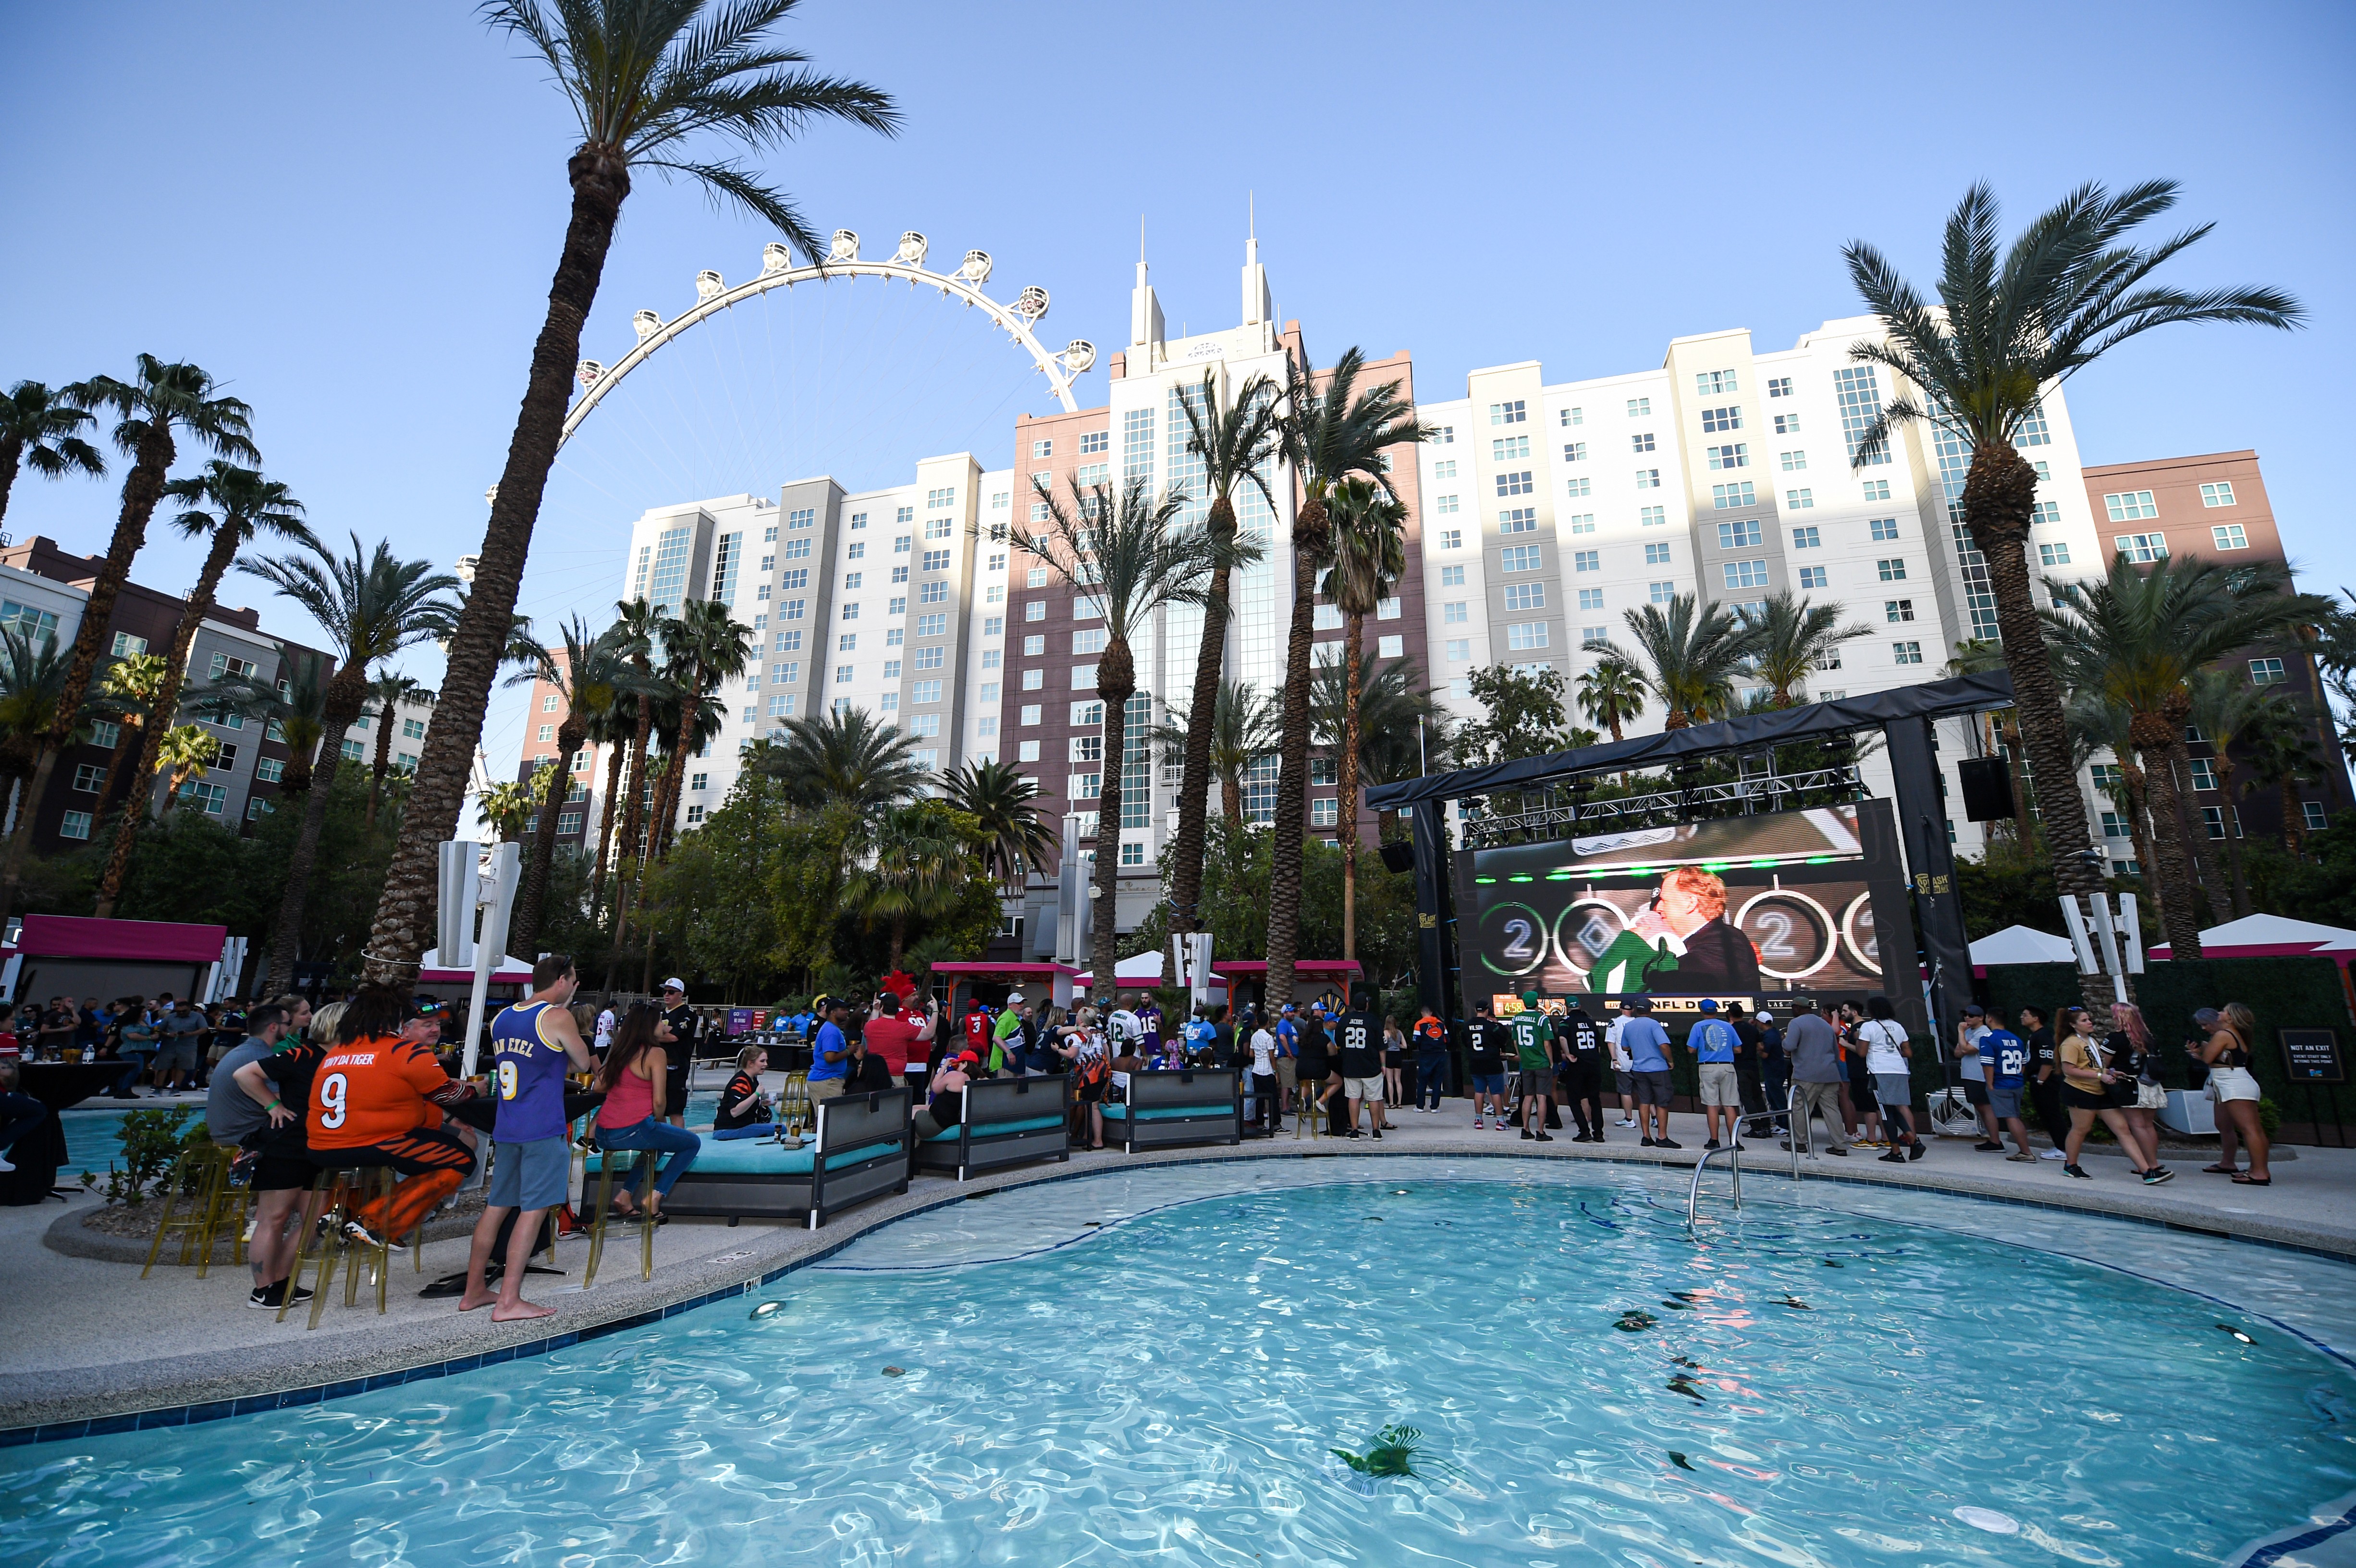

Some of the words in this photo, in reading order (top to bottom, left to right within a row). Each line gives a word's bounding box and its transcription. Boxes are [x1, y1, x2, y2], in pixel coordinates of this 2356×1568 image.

[1504, 1002, 1522, 1013] 4:58
[596, 1021, 603, 1036] 6
[973, 1021, 981, 1033] 3
[1111, 1022, 1125, 1043] 12
[1141, 1016, 1156, 1034] 16
[1345, 1027, 1366, 1049] 28
[1472, 1033, 1484, 1051] 2
[1516, 1025, 1534, 1046] 15
[1576, 1031, 1595, 1050] 26
[493, 1038, 505, 1056] AN
[507, 1038, 534, 1058] EXEL
[2039, 1049, 2054, 1059] 98
[337, 1054, 351, 1066] DA
[349, 1053, 375, 1066] TIGER
[2001, 1050, 2022, 1075] 28
[499, 1061, 517, 1100] 9
[320, 1072, 347, 1129] 9
